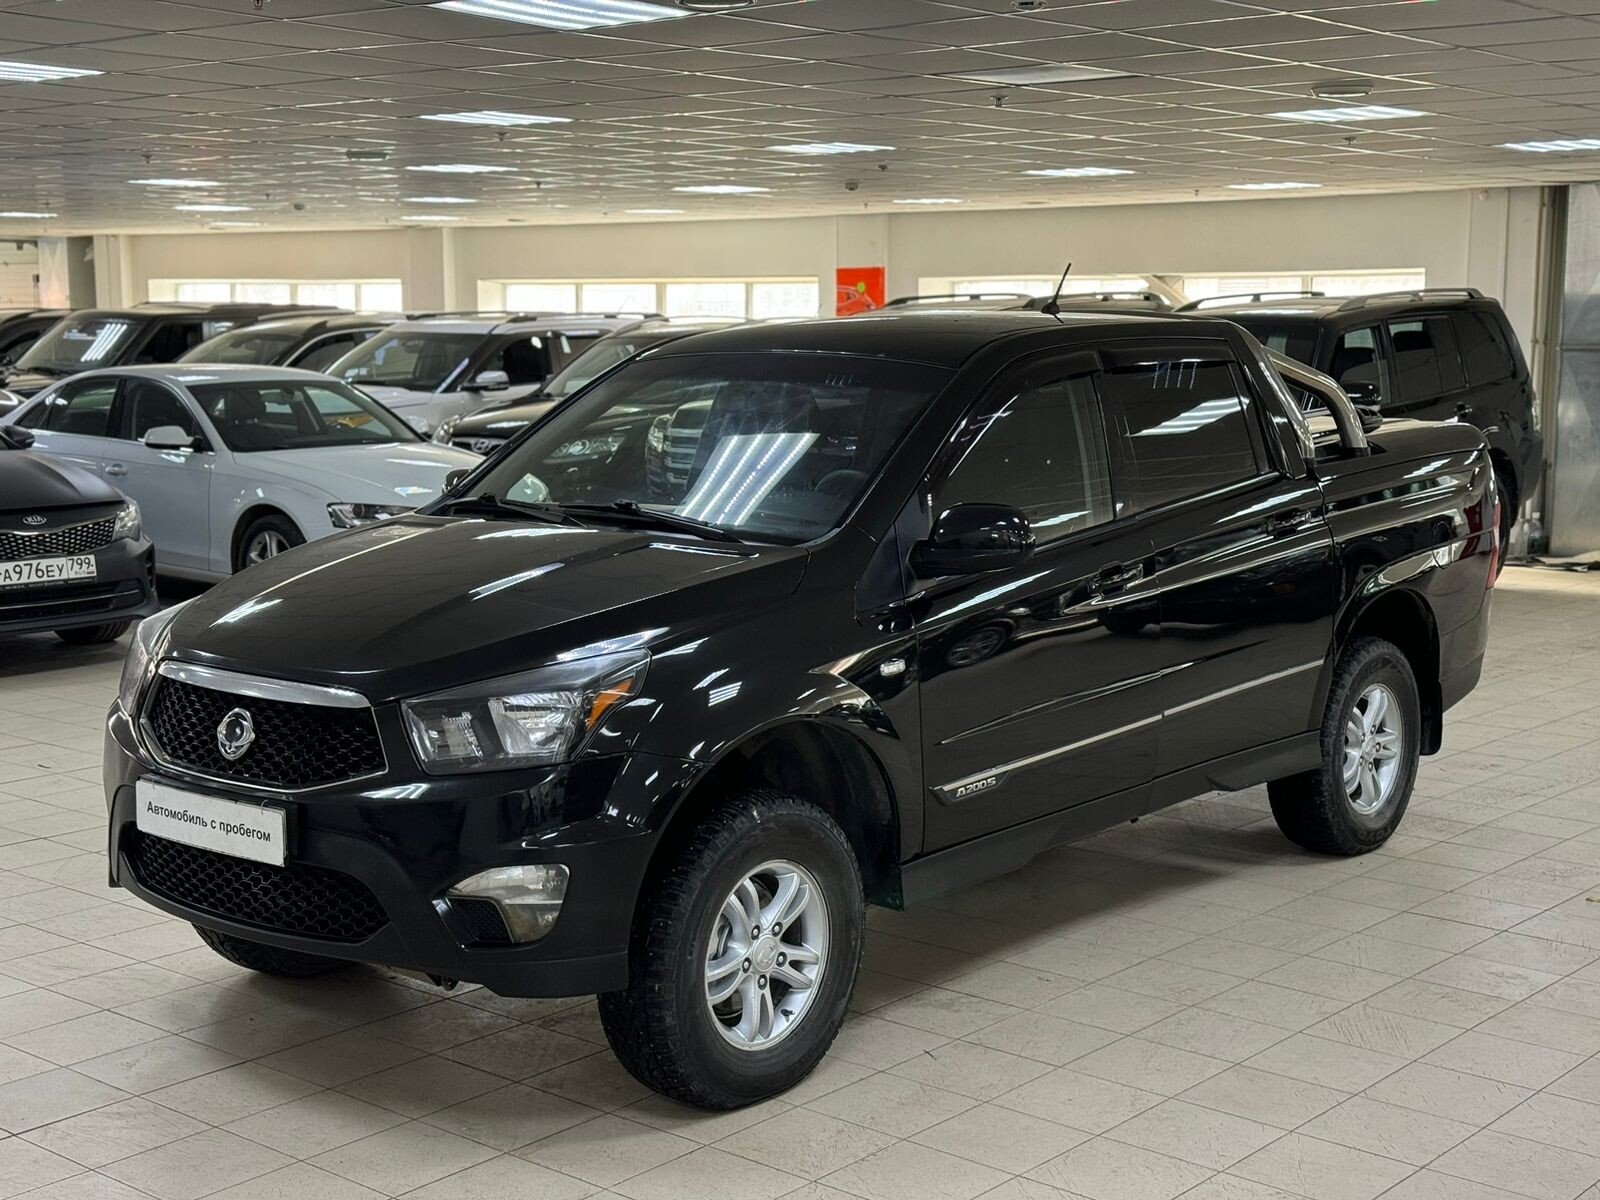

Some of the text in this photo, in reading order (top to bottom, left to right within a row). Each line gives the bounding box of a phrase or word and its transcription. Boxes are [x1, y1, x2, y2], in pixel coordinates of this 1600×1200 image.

[67, 556, 91, 572] 799
[956, 776, 997, 798] A200S
[146, 800, 271, 843] Автомобиль с пробегом
